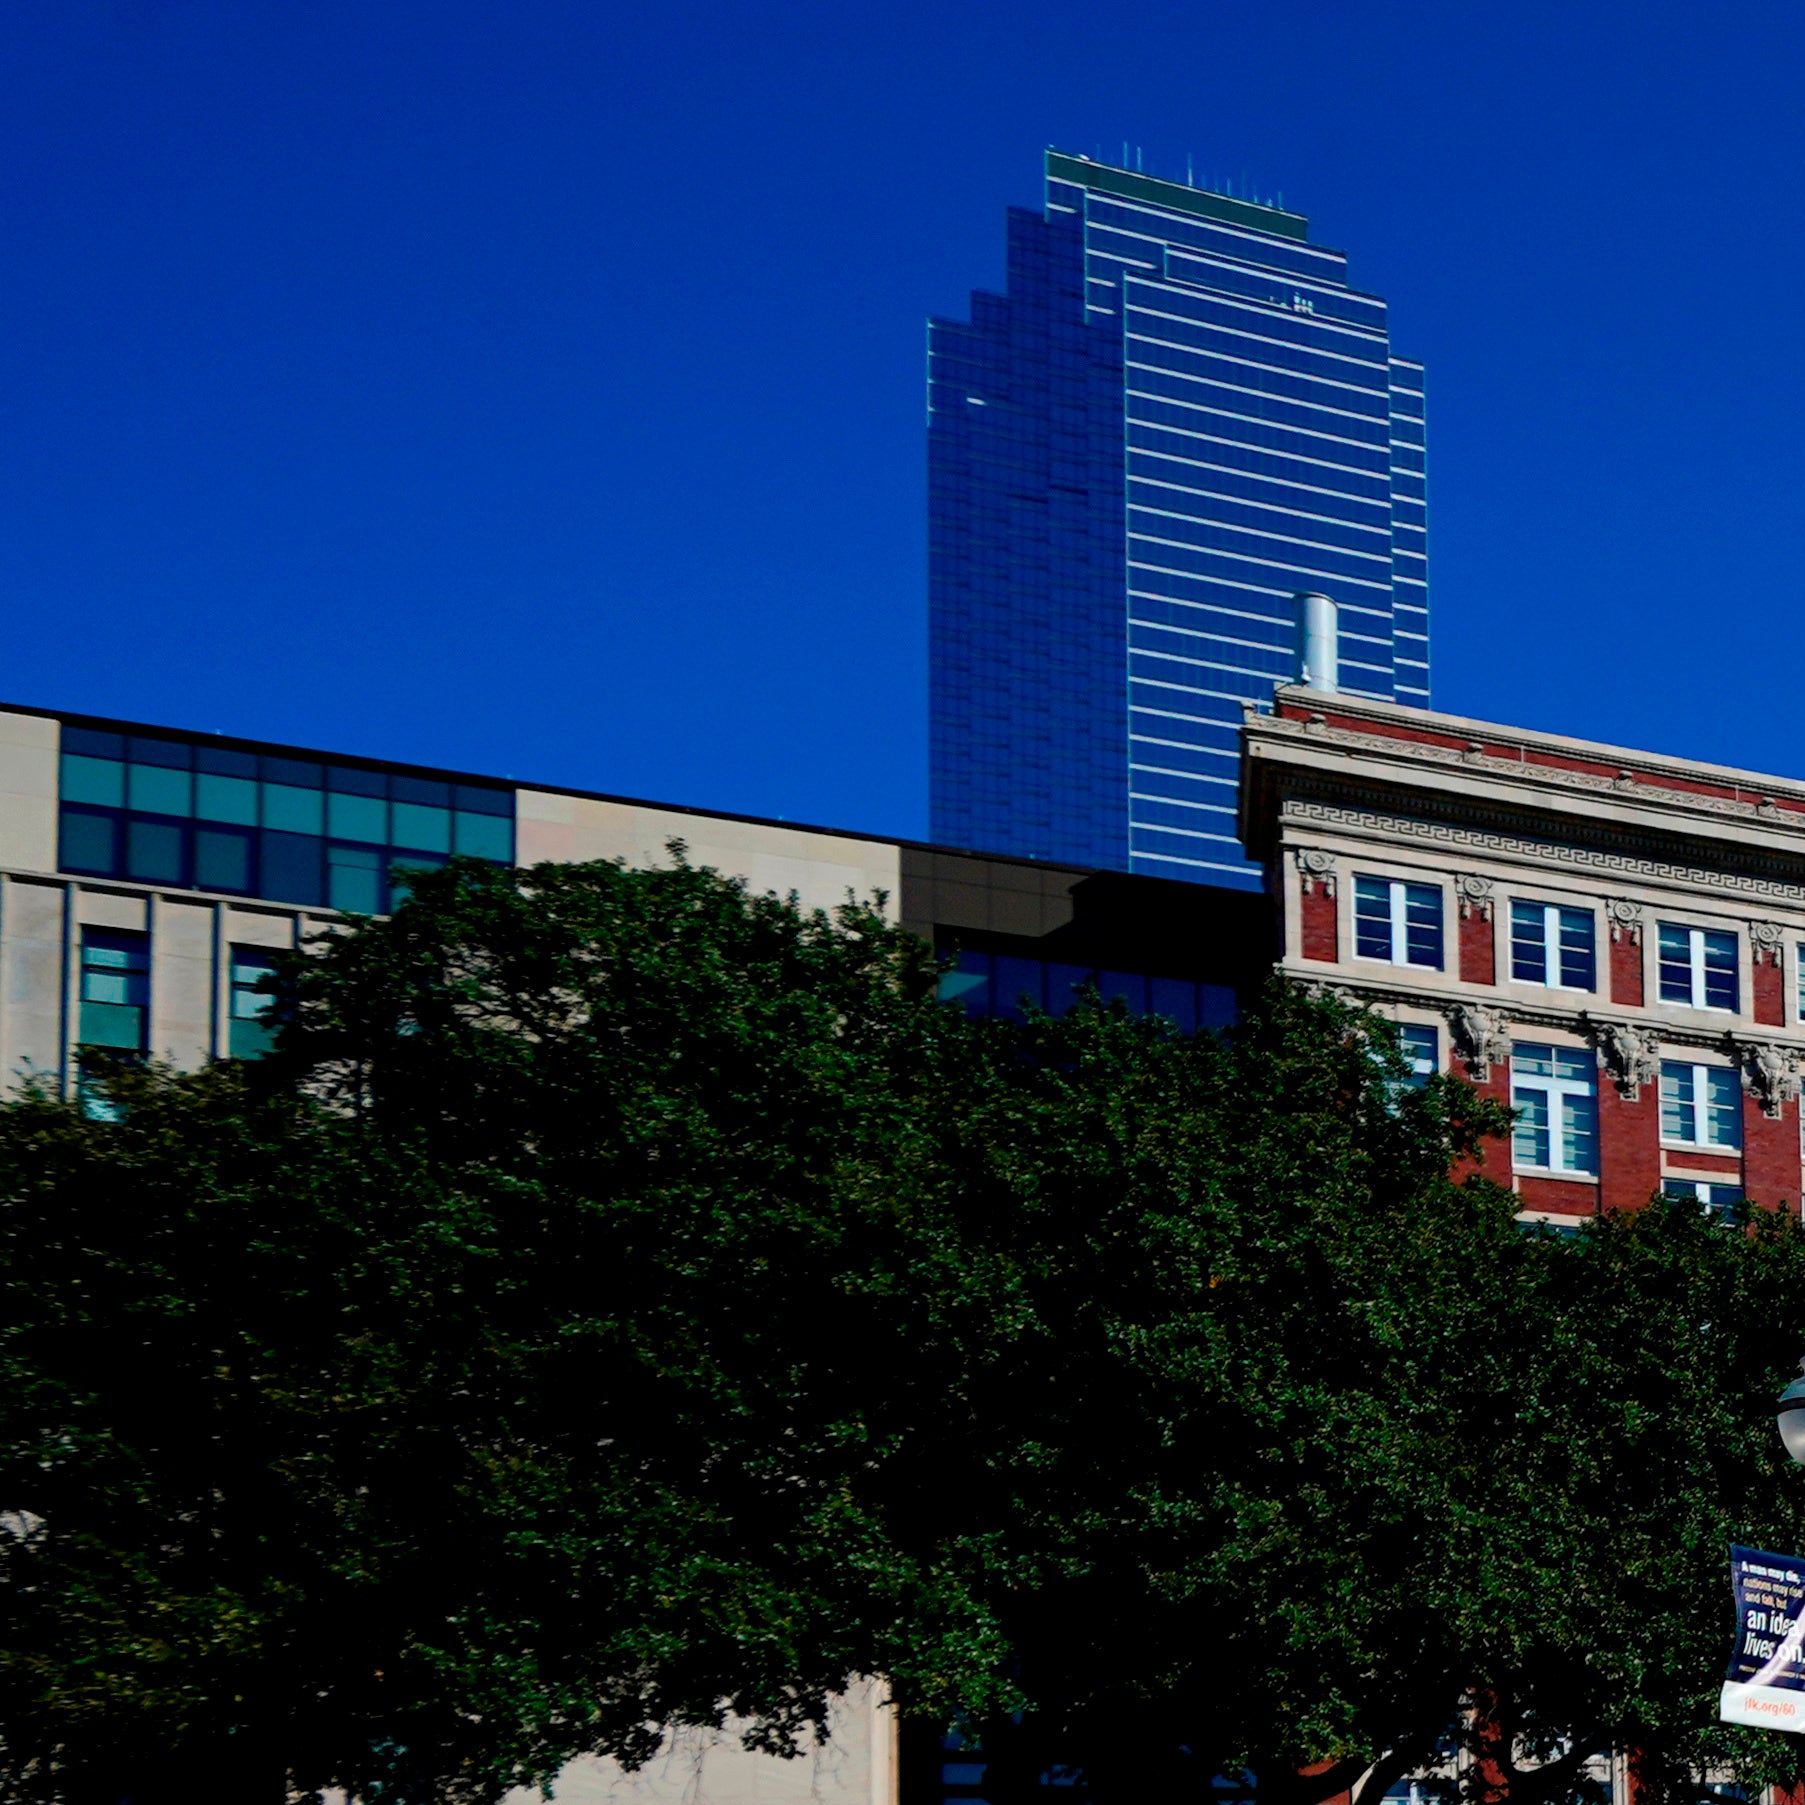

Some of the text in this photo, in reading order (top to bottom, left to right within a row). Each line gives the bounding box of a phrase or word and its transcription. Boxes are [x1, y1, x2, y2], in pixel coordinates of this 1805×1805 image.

[1746, 1609, 1767, 1631] an
[1743, 1631, 1776, 1660] lives
[1743, 1697, 1796, 1716] jfk.org/60
